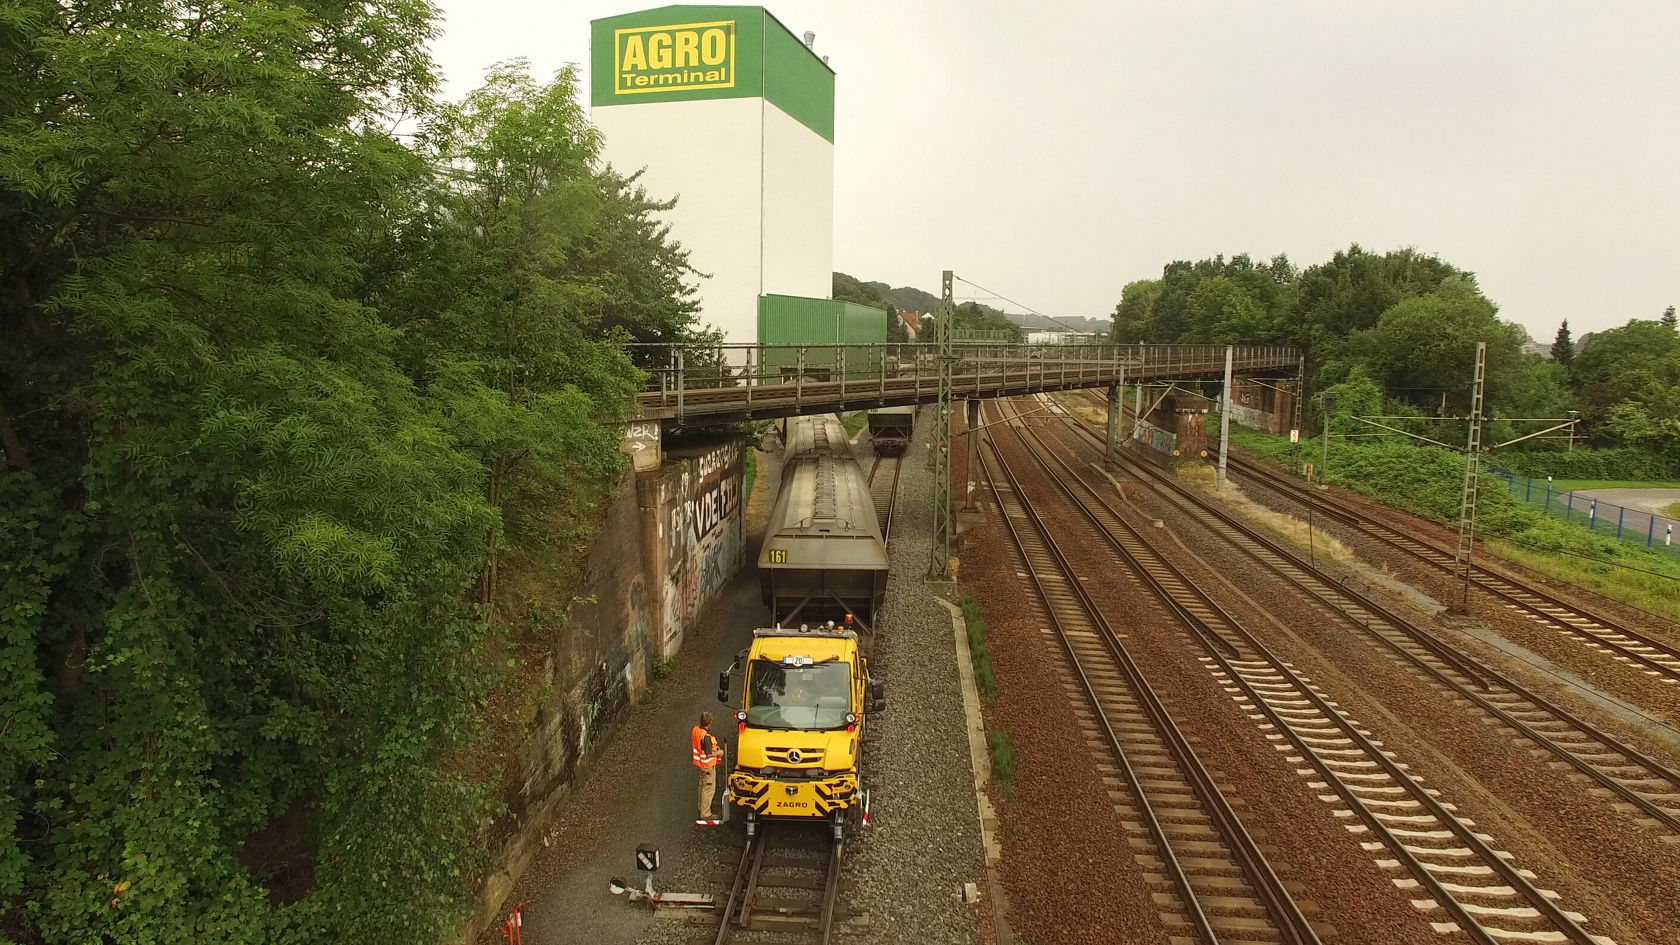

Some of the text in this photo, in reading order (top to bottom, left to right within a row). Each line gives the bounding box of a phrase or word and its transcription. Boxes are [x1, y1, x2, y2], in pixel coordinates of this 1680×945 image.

[622, 28, 726, 71] AGRO
[622, 67, 726, 87] Terminal
[770, 550, 786, 564] 161
[794, 656, 803, 665] 20
